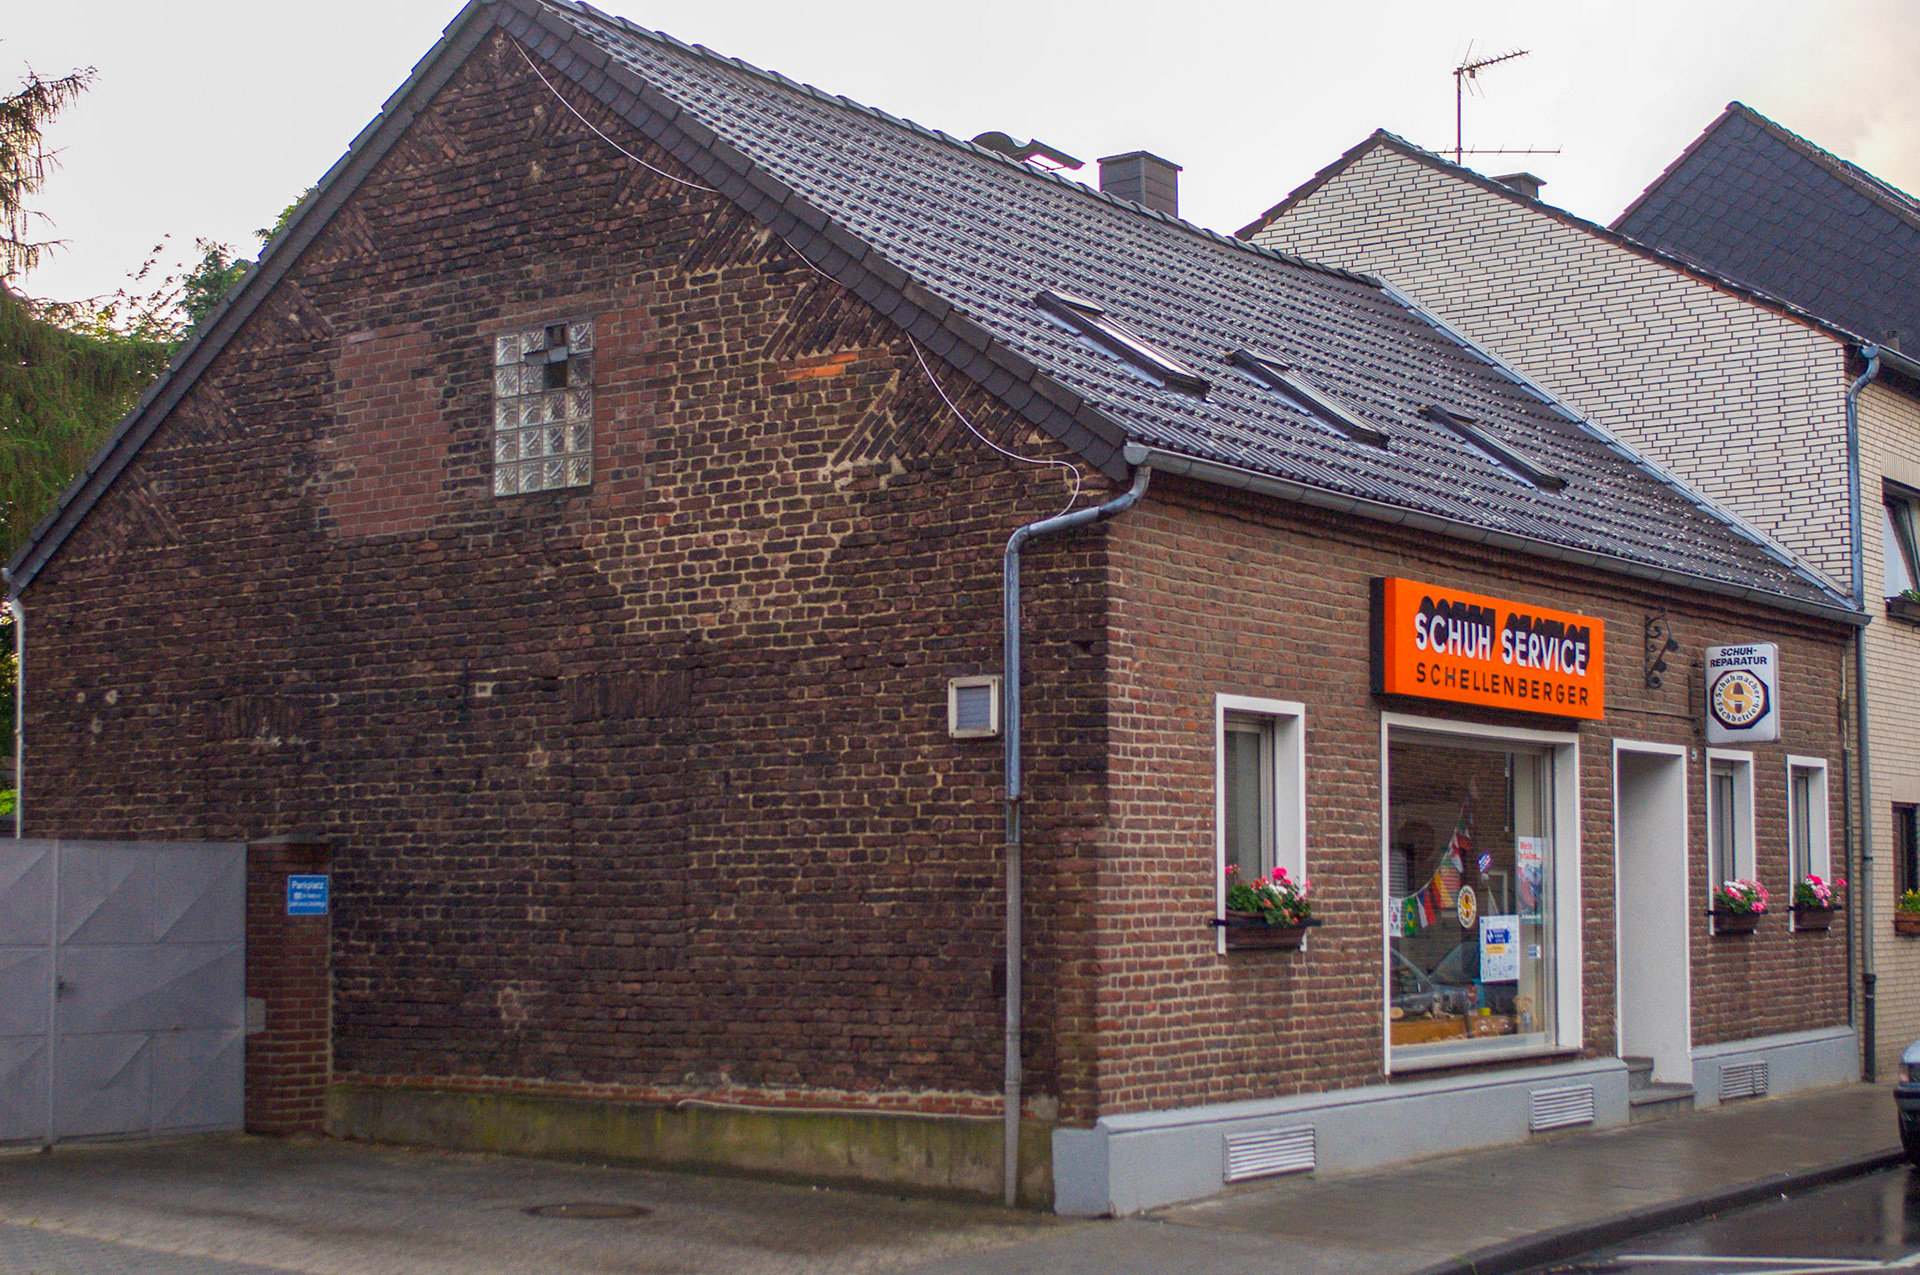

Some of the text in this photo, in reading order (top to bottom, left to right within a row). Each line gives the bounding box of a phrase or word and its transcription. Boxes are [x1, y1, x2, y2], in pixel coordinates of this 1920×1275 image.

[1414, 612, 1586, 677] SCHUH SERVICE
[1720, 647, 1757, 656] SCHUH-
[1710, 656, 1767, 668] REPARATUR
[1416, 662, 1589, 706] SCHELLENBERGER
[1715, 674, 1760, 700] Schuhmacher
[291, 880, 324, 891] Parkplatz
